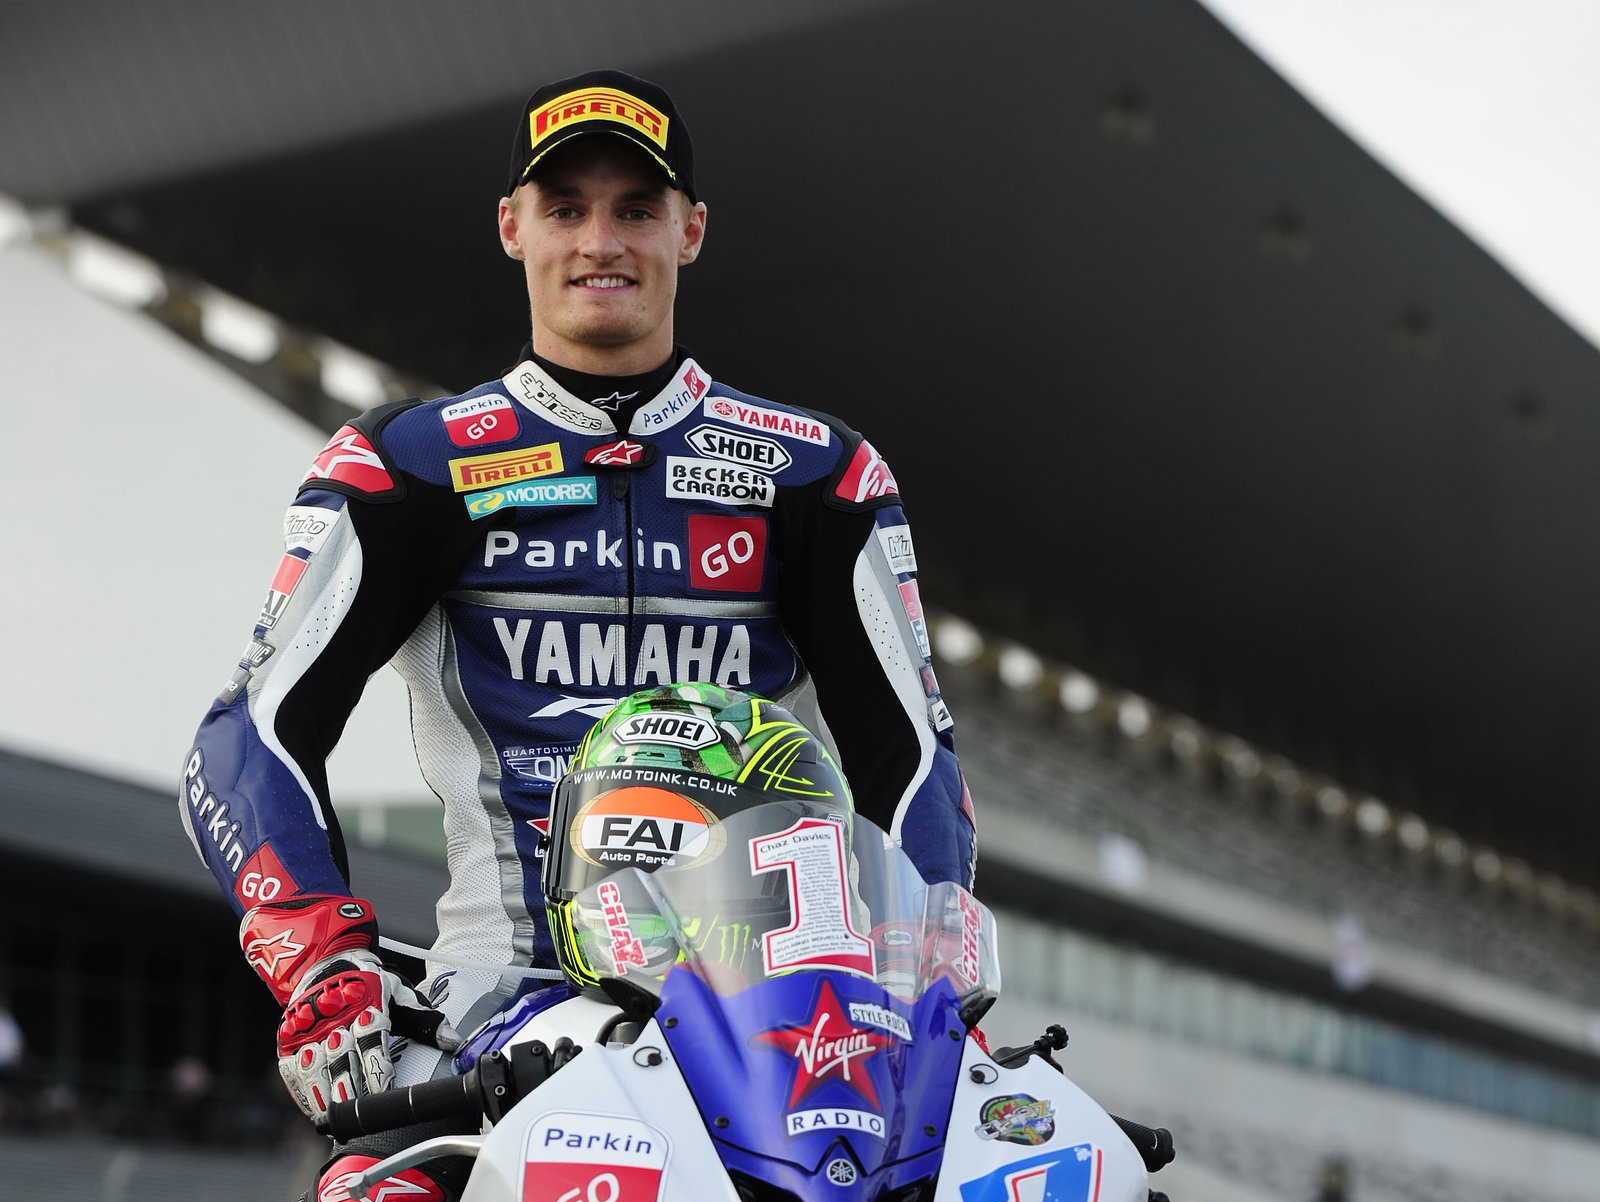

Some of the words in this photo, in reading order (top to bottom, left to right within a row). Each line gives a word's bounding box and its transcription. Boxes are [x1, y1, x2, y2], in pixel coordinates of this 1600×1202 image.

[536, 93, 662, 138] PIRELLI
[448, 399, 503, 416] Parkin
[520, 373, 602, 430] alpinestars
[643, 391, 692, 427] Parkin
[690, 371, 699, 395] GO
[466, 415, 498, 440] GO
[737, 407, 822, 441] YAMAHA
[702, 434, 775, 465] SHOEI
[461, 451, 552, 486] PIRELLI
[673, 464, 767, 487] BECKER
[506, 483, 595, 502] MOTOREX
[673, 479, 768, 501] CARBON
[484, 528, 682, 571] Parkin
[701, 530, 754, 578] GO
[493, 618, 751, 686] YAMAHA
[626, 716, 706, 742] SHOEI
[185, 749, 245, 873] Parkin
[241, 872, 281, 901] GO
[600, 817, 684, 851] FAI
[760, 839, 789, 854] Chaz
[793, 832, 832, 844] Davies
[599, 851, 631, 862] Auto
[636, 853, 676, 867] Parts
[852, 1008, 884, 1025] STYLE
[885, 1013, 908, 1034] ROCK
[795, 1013, 876, 1081] Virgin
[793, 1112, 882, 1133] RADIO
[544, 1128, 652, 1154] Parkin
